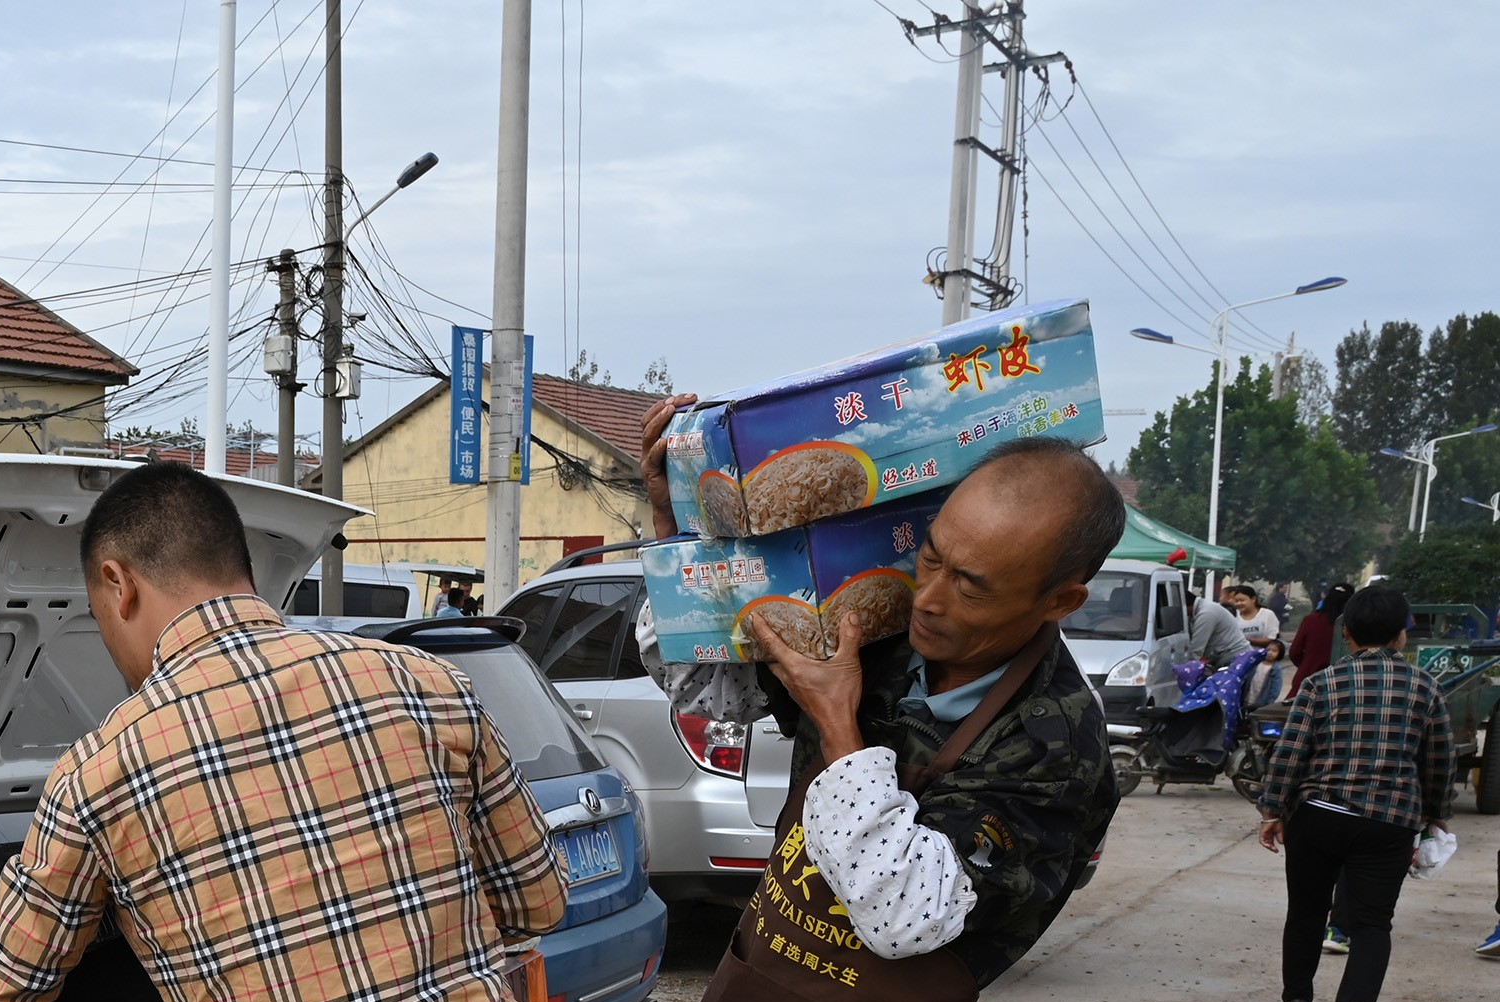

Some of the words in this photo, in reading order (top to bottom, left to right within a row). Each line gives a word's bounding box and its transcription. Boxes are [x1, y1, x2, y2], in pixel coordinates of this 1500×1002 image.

[942, 324, 1042, 394] 虾皮
[957, 396, 1048, 448] 来自于海洋的
[1017, 402, 1080, 438] 鲜香美味
[882, 458, 939, 486] 好味道
[694, 644, 730, 660] 好味道
